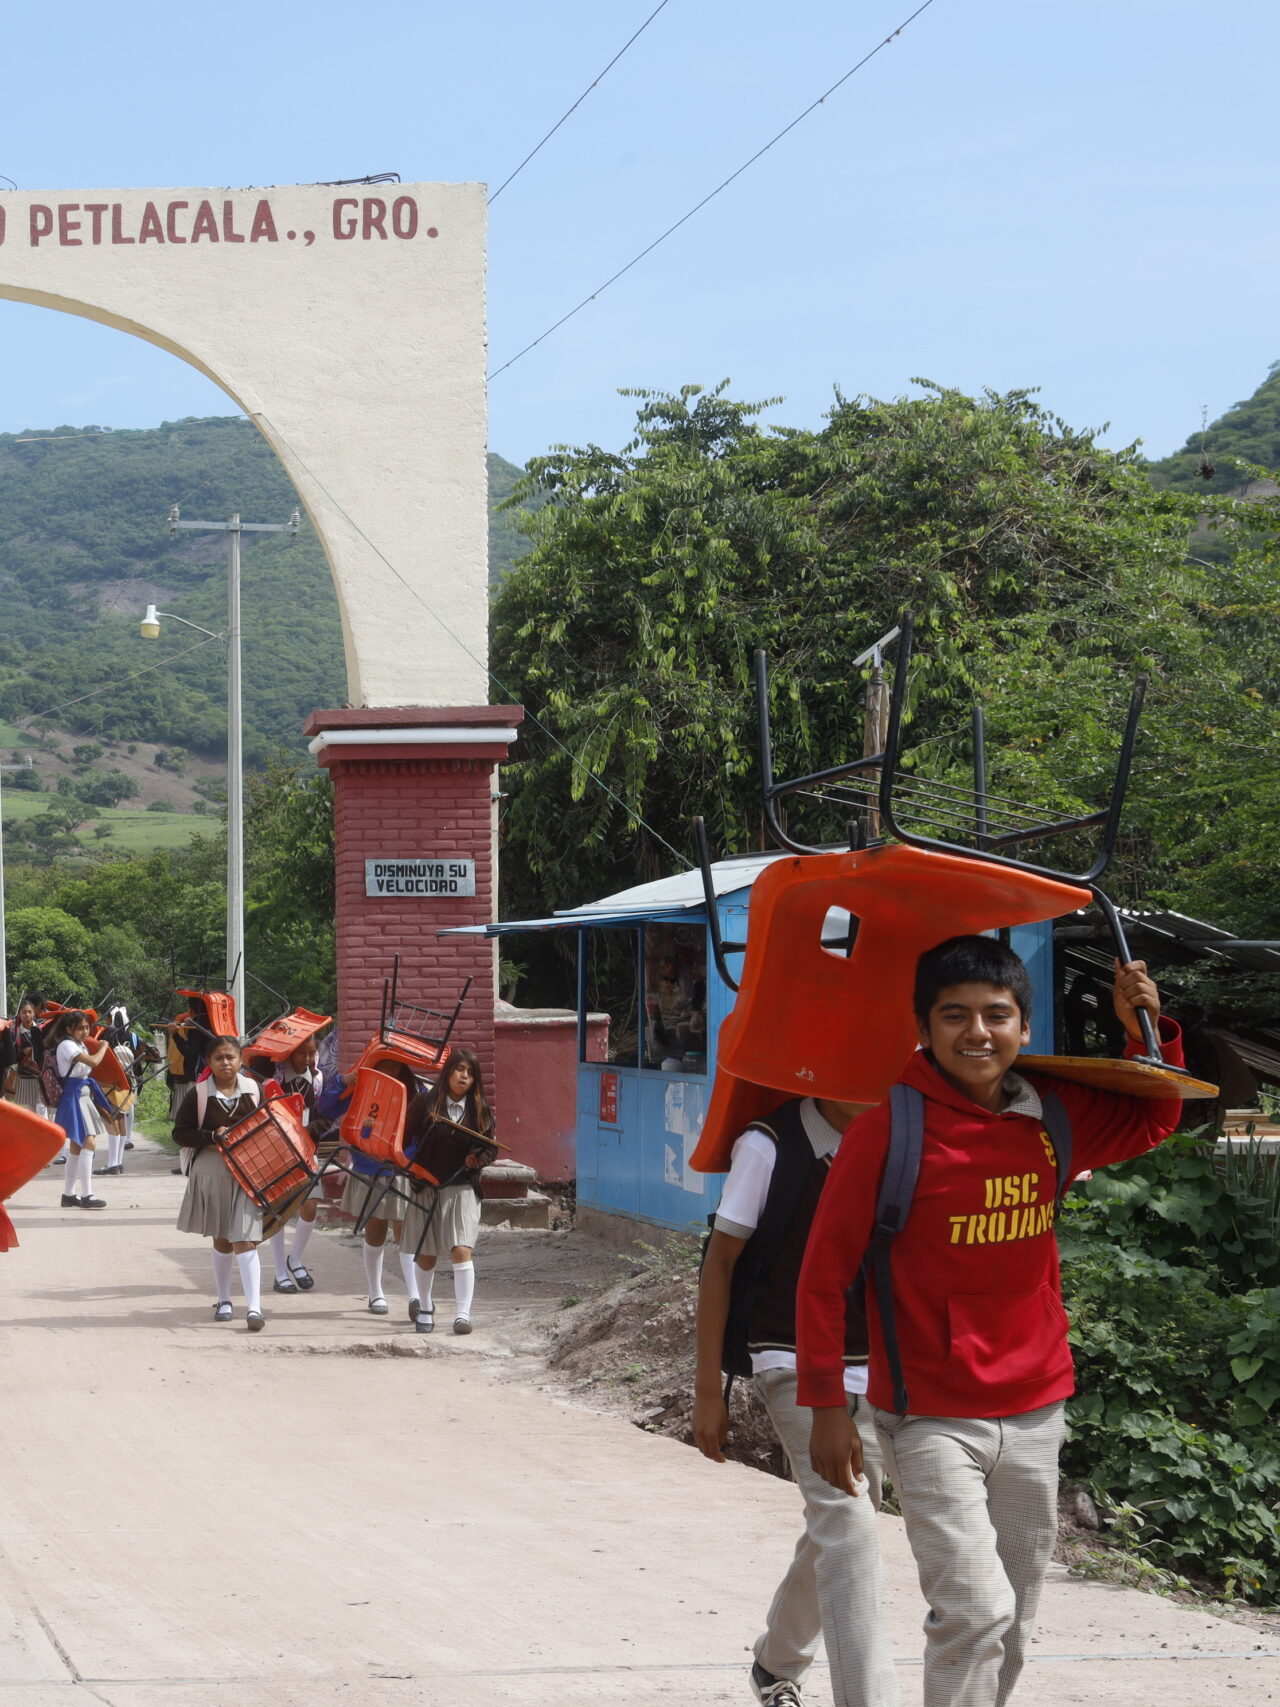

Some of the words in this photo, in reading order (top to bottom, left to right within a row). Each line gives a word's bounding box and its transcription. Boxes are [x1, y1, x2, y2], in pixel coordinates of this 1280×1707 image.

[332, 195, 439, 241] GRO.
[374, 864, 445, 878] DISMINUYA
[449, 864, 467, 878] SU
[376, 879, 458, 893] VELOCIDAD
[368, 1102, 380, 1119] 2
[984, 1172, 1039, 1209] USC
